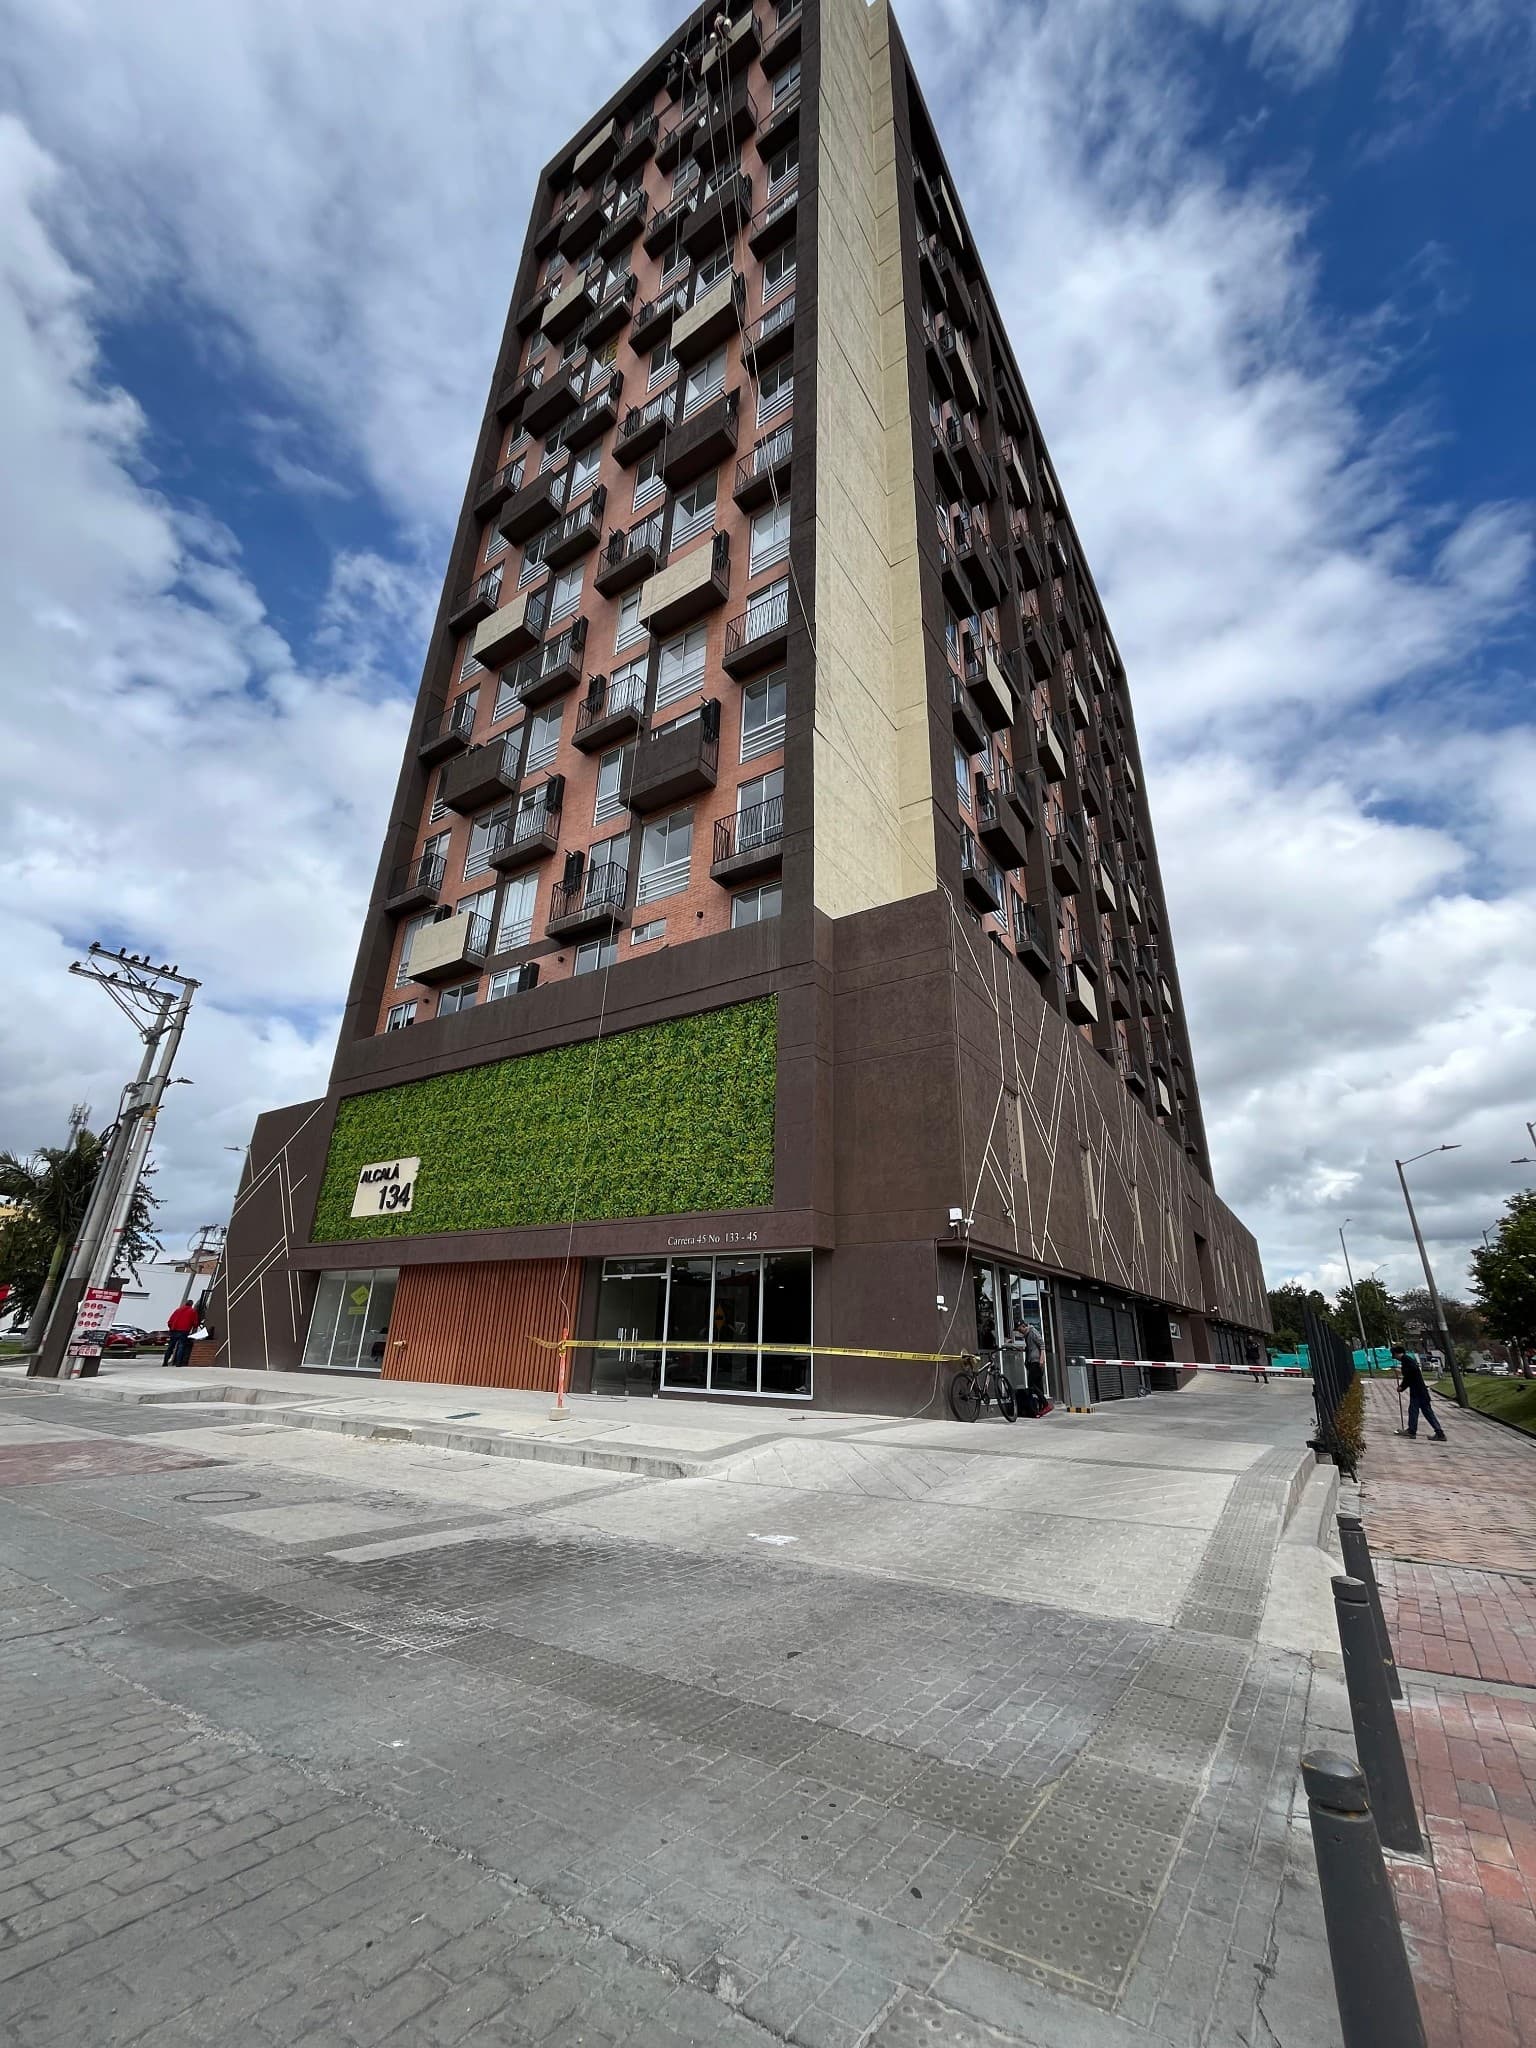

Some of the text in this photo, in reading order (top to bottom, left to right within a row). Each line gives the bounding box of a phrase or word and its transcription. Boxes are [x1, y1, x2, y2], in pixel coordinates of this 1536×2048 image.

[360, 1163, 400, 1183] ALCALÁ
[379, 1182, 411, 1210] 134
[667, 1236, 695, 1246] Carrera
[696, 1234, 706, 1244] 45
[708, 1234, 720, 1243] No
[725, 1232, 739, 1242] 133
[746, 1231, 758, 1241] 45
